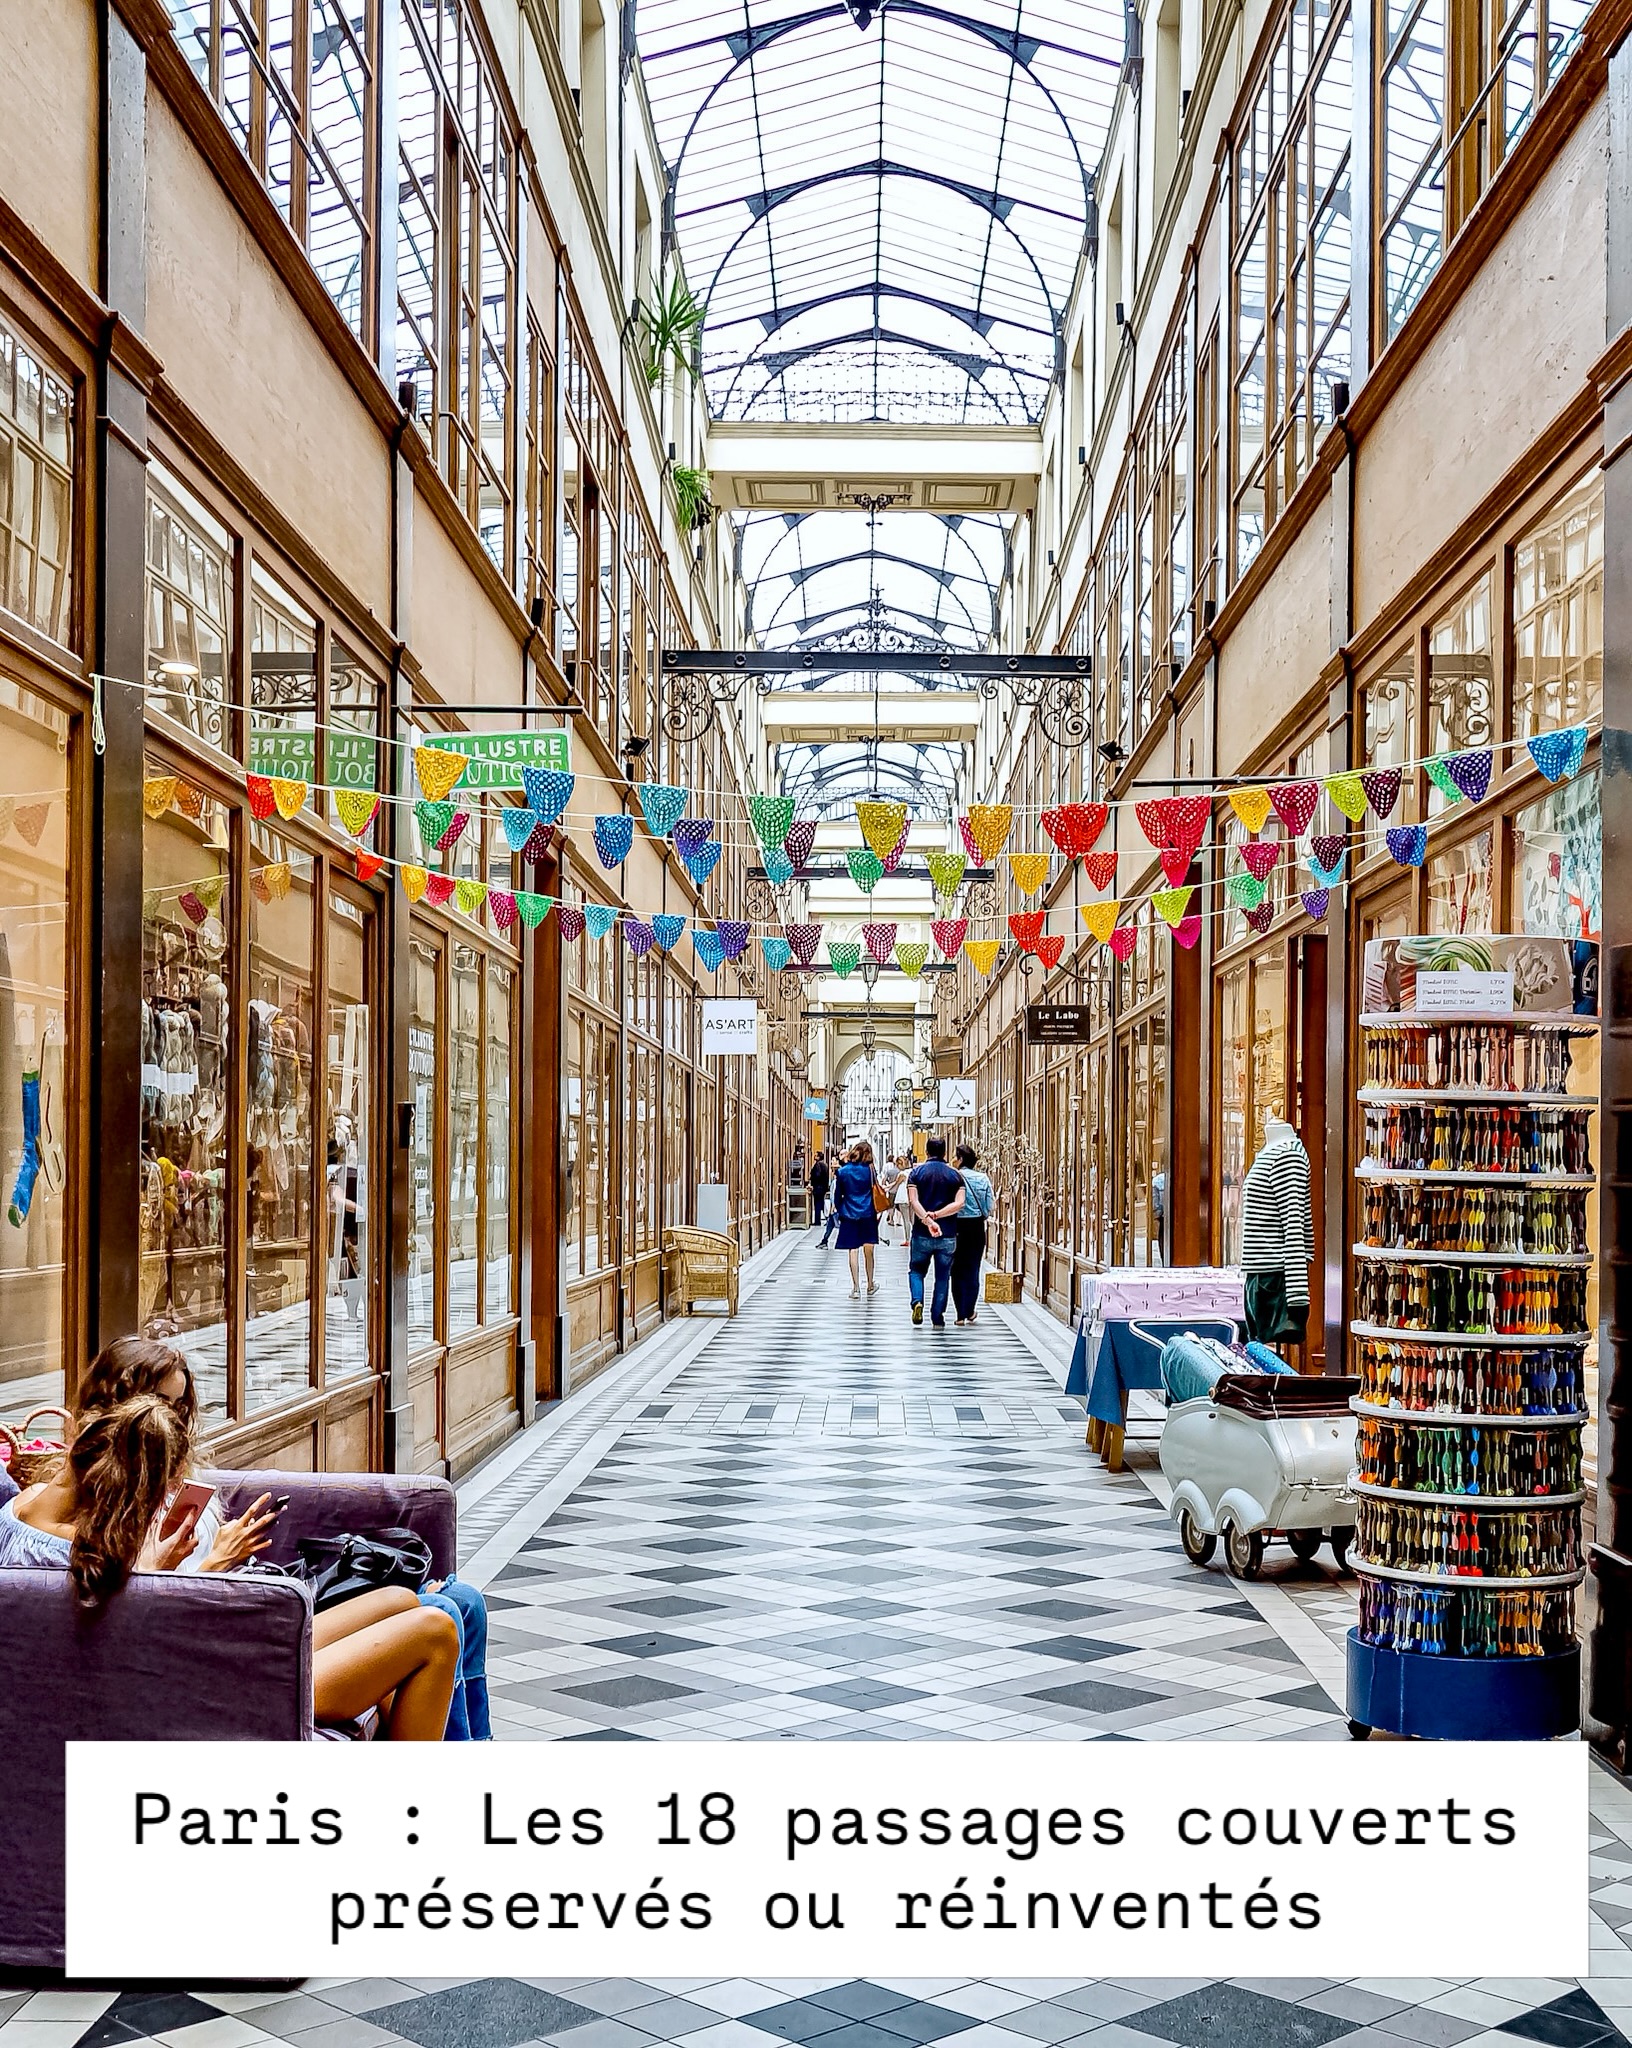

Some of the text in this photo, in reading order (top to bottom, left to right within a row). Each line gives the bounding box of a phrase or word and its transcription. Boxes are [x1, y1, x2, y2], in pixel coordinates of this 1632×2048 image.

[1038, 1011, 1080, 1020] Le Labo
[705, 1018, 756, 1030] AS'ART
